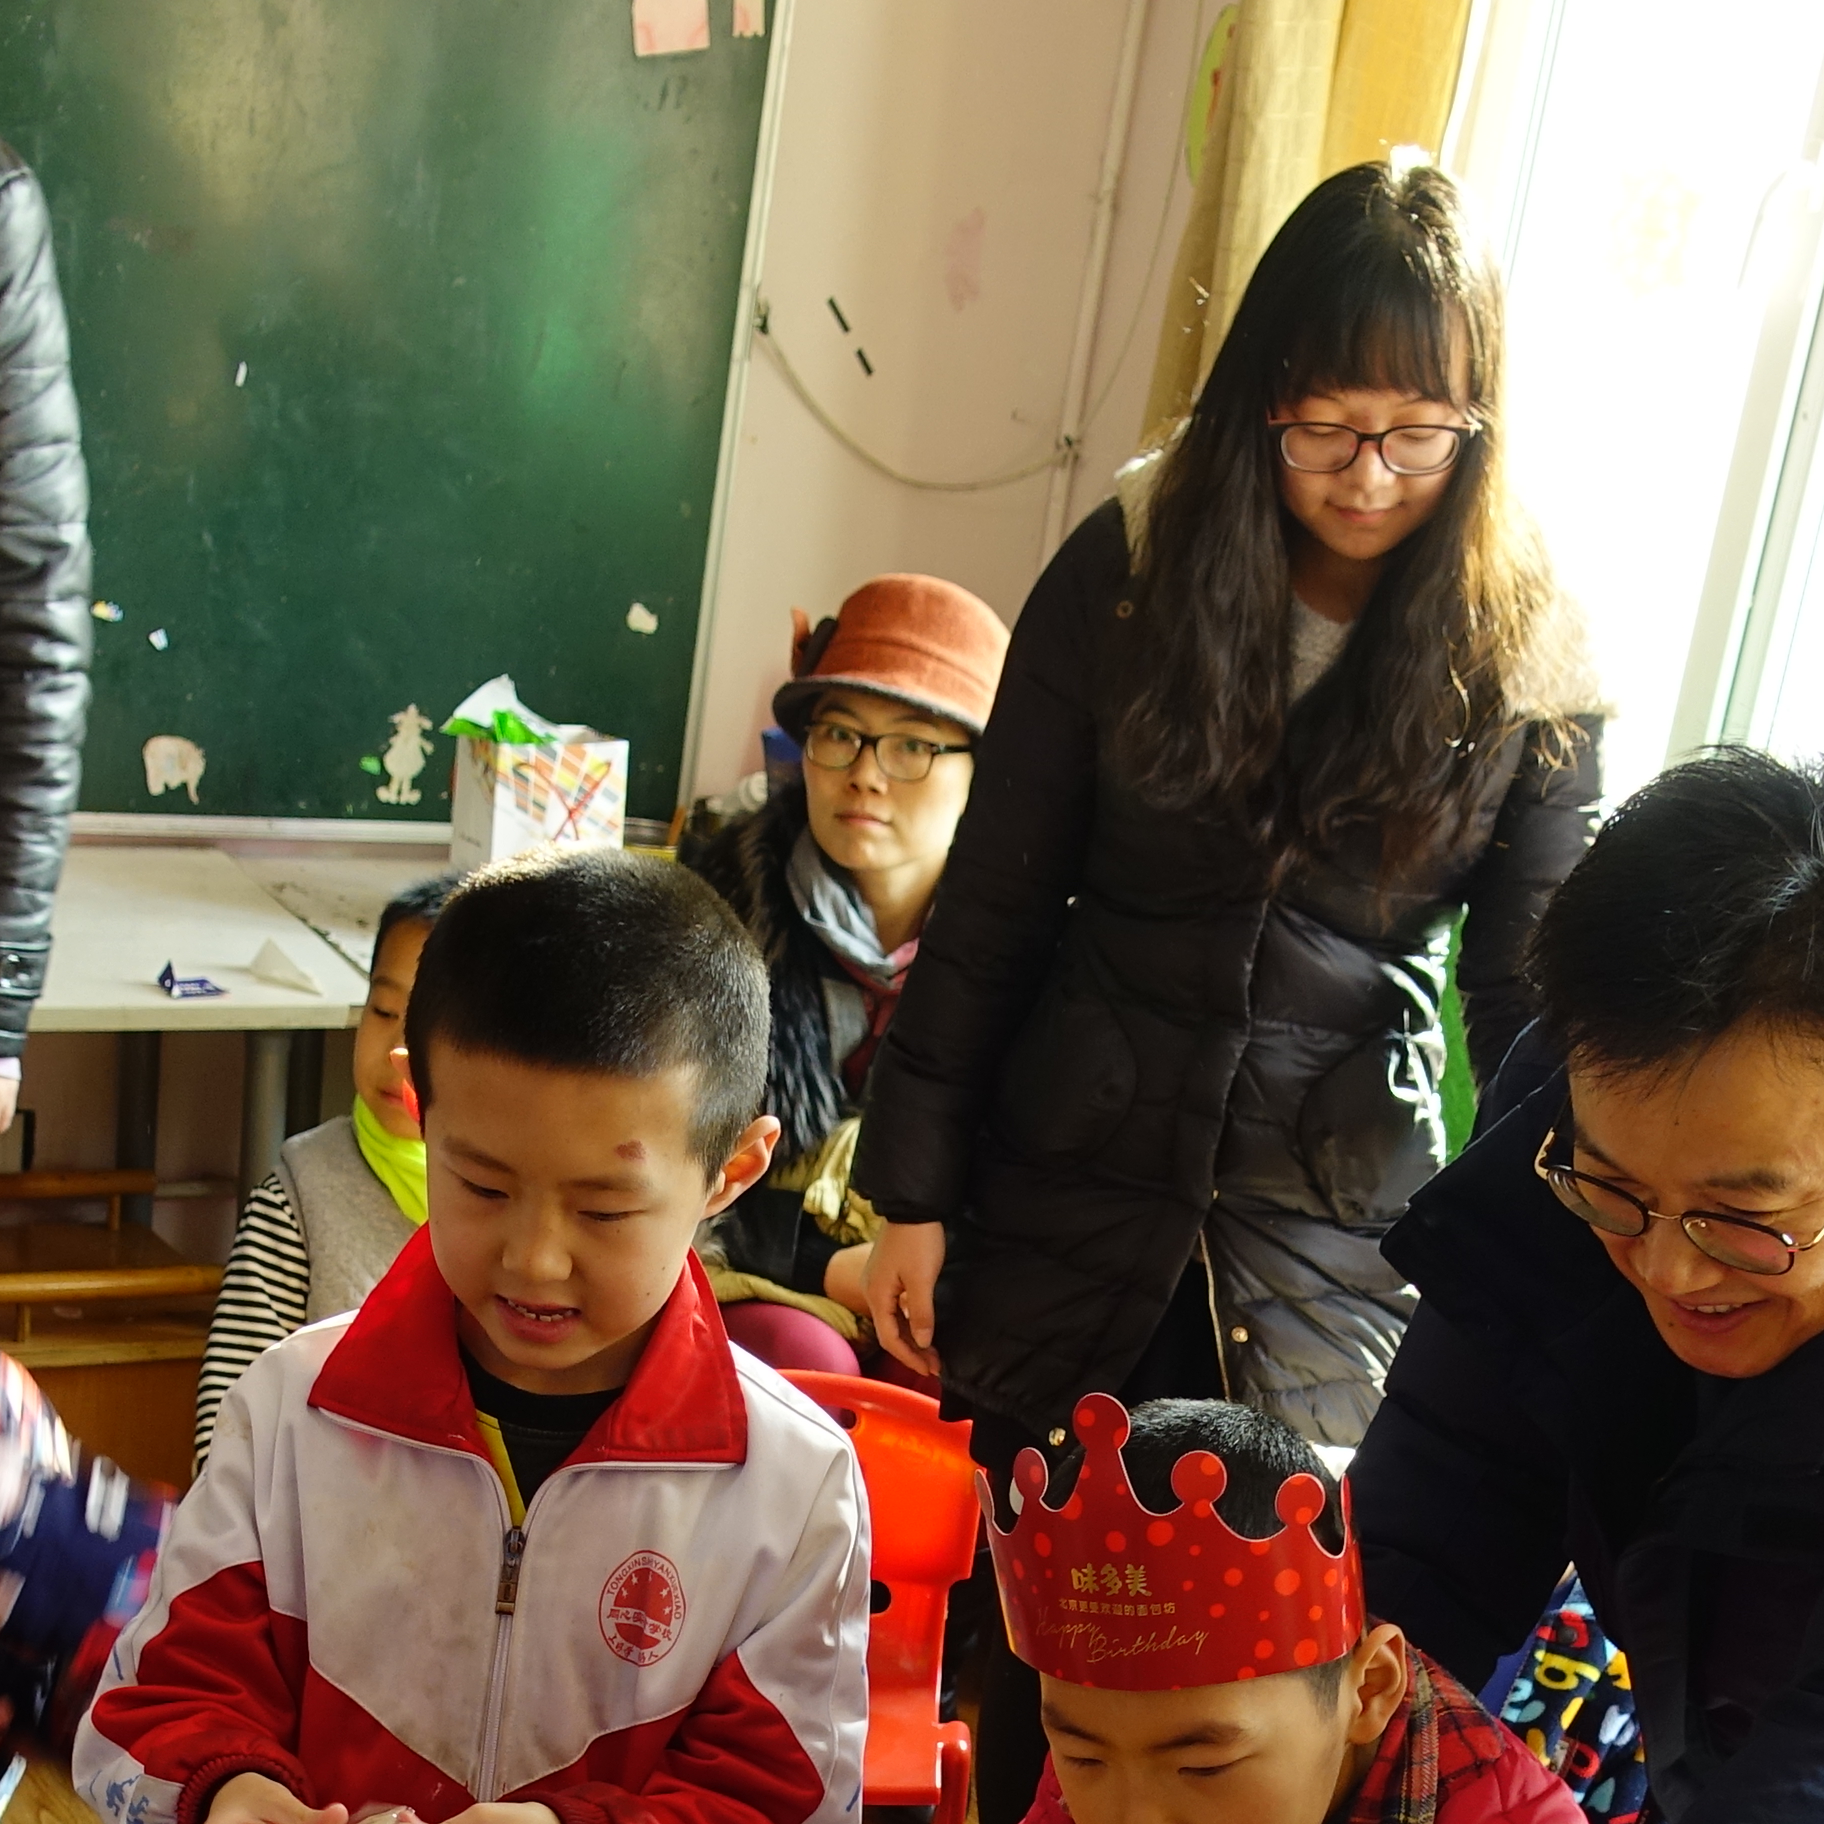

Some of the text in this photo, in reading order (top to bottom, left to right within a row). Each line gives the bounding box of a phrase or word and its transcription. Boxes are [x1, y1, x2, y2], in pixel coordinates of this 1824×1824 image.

[1070, 1562, 1152, 1597] 味多美
[1036, 1606, 1101, 1649] Happy
[1086, 1625, 1209, 1663] Birthday
